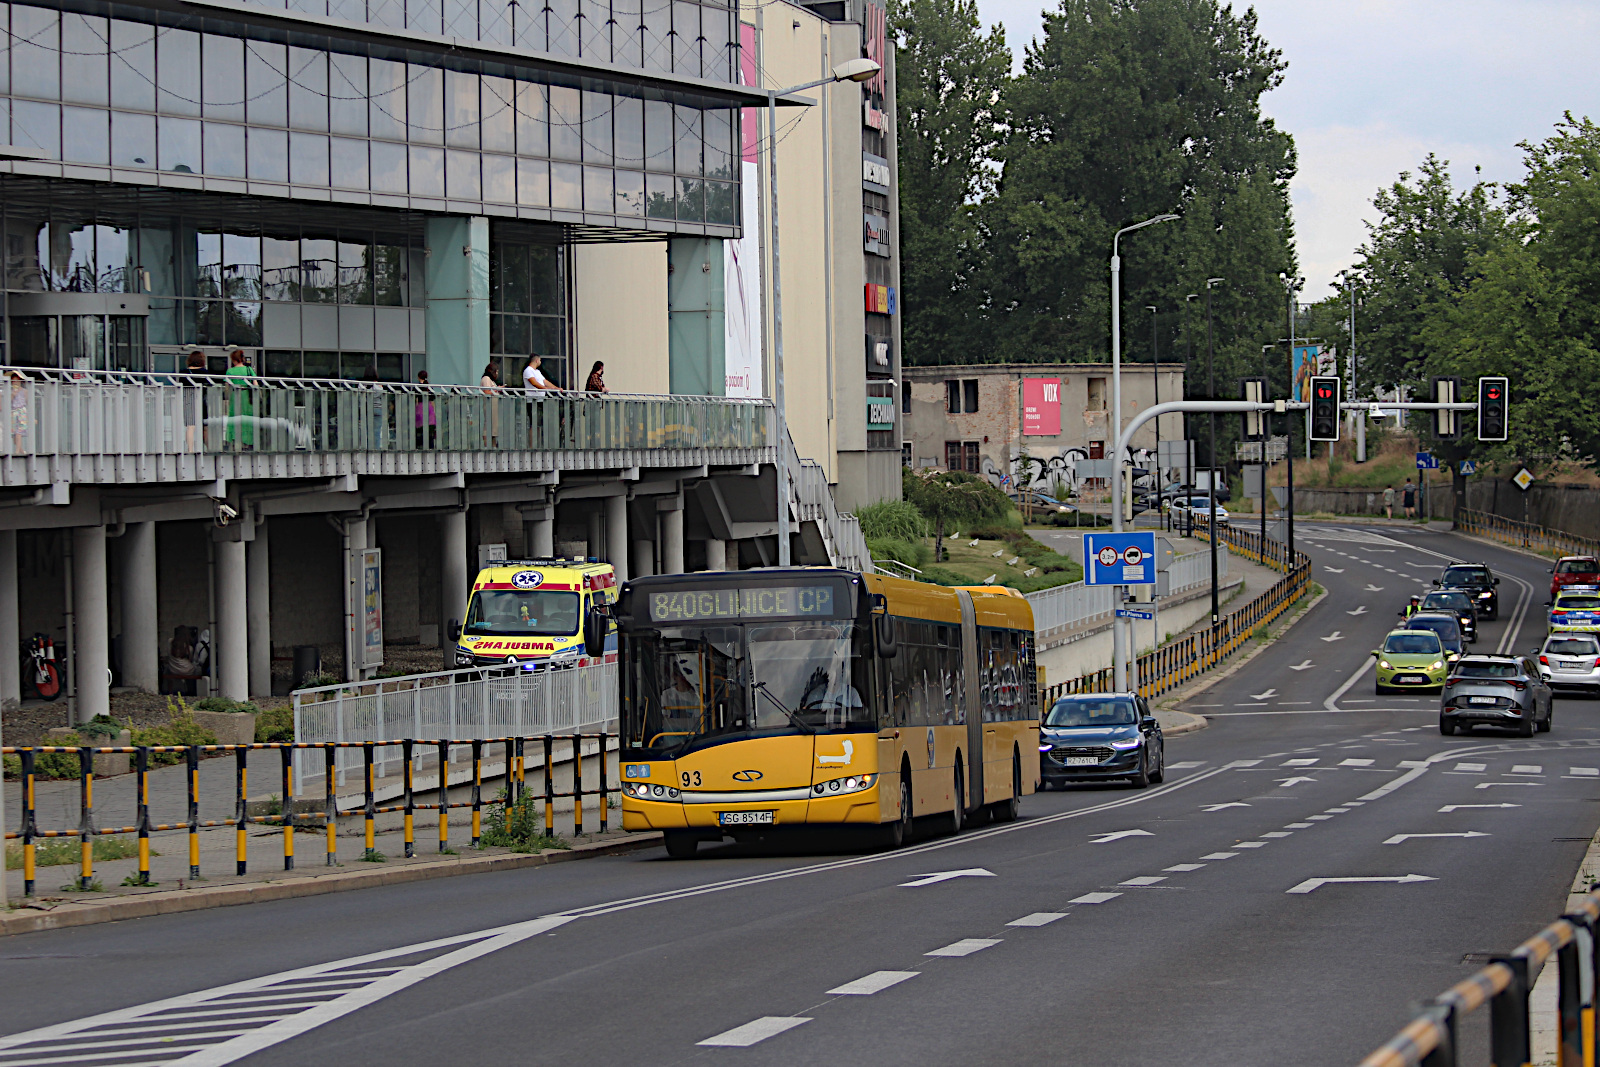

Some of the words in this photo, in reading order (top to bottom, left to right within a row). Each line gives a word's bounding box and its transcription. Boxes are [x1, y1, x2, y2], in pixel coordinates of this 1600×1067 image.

[1043, 383, 1058, 402] VOX
[798, 588, 830, 612] CP
[681, 770, 702, 787] 93
[725, 813, 740, 823] SG
